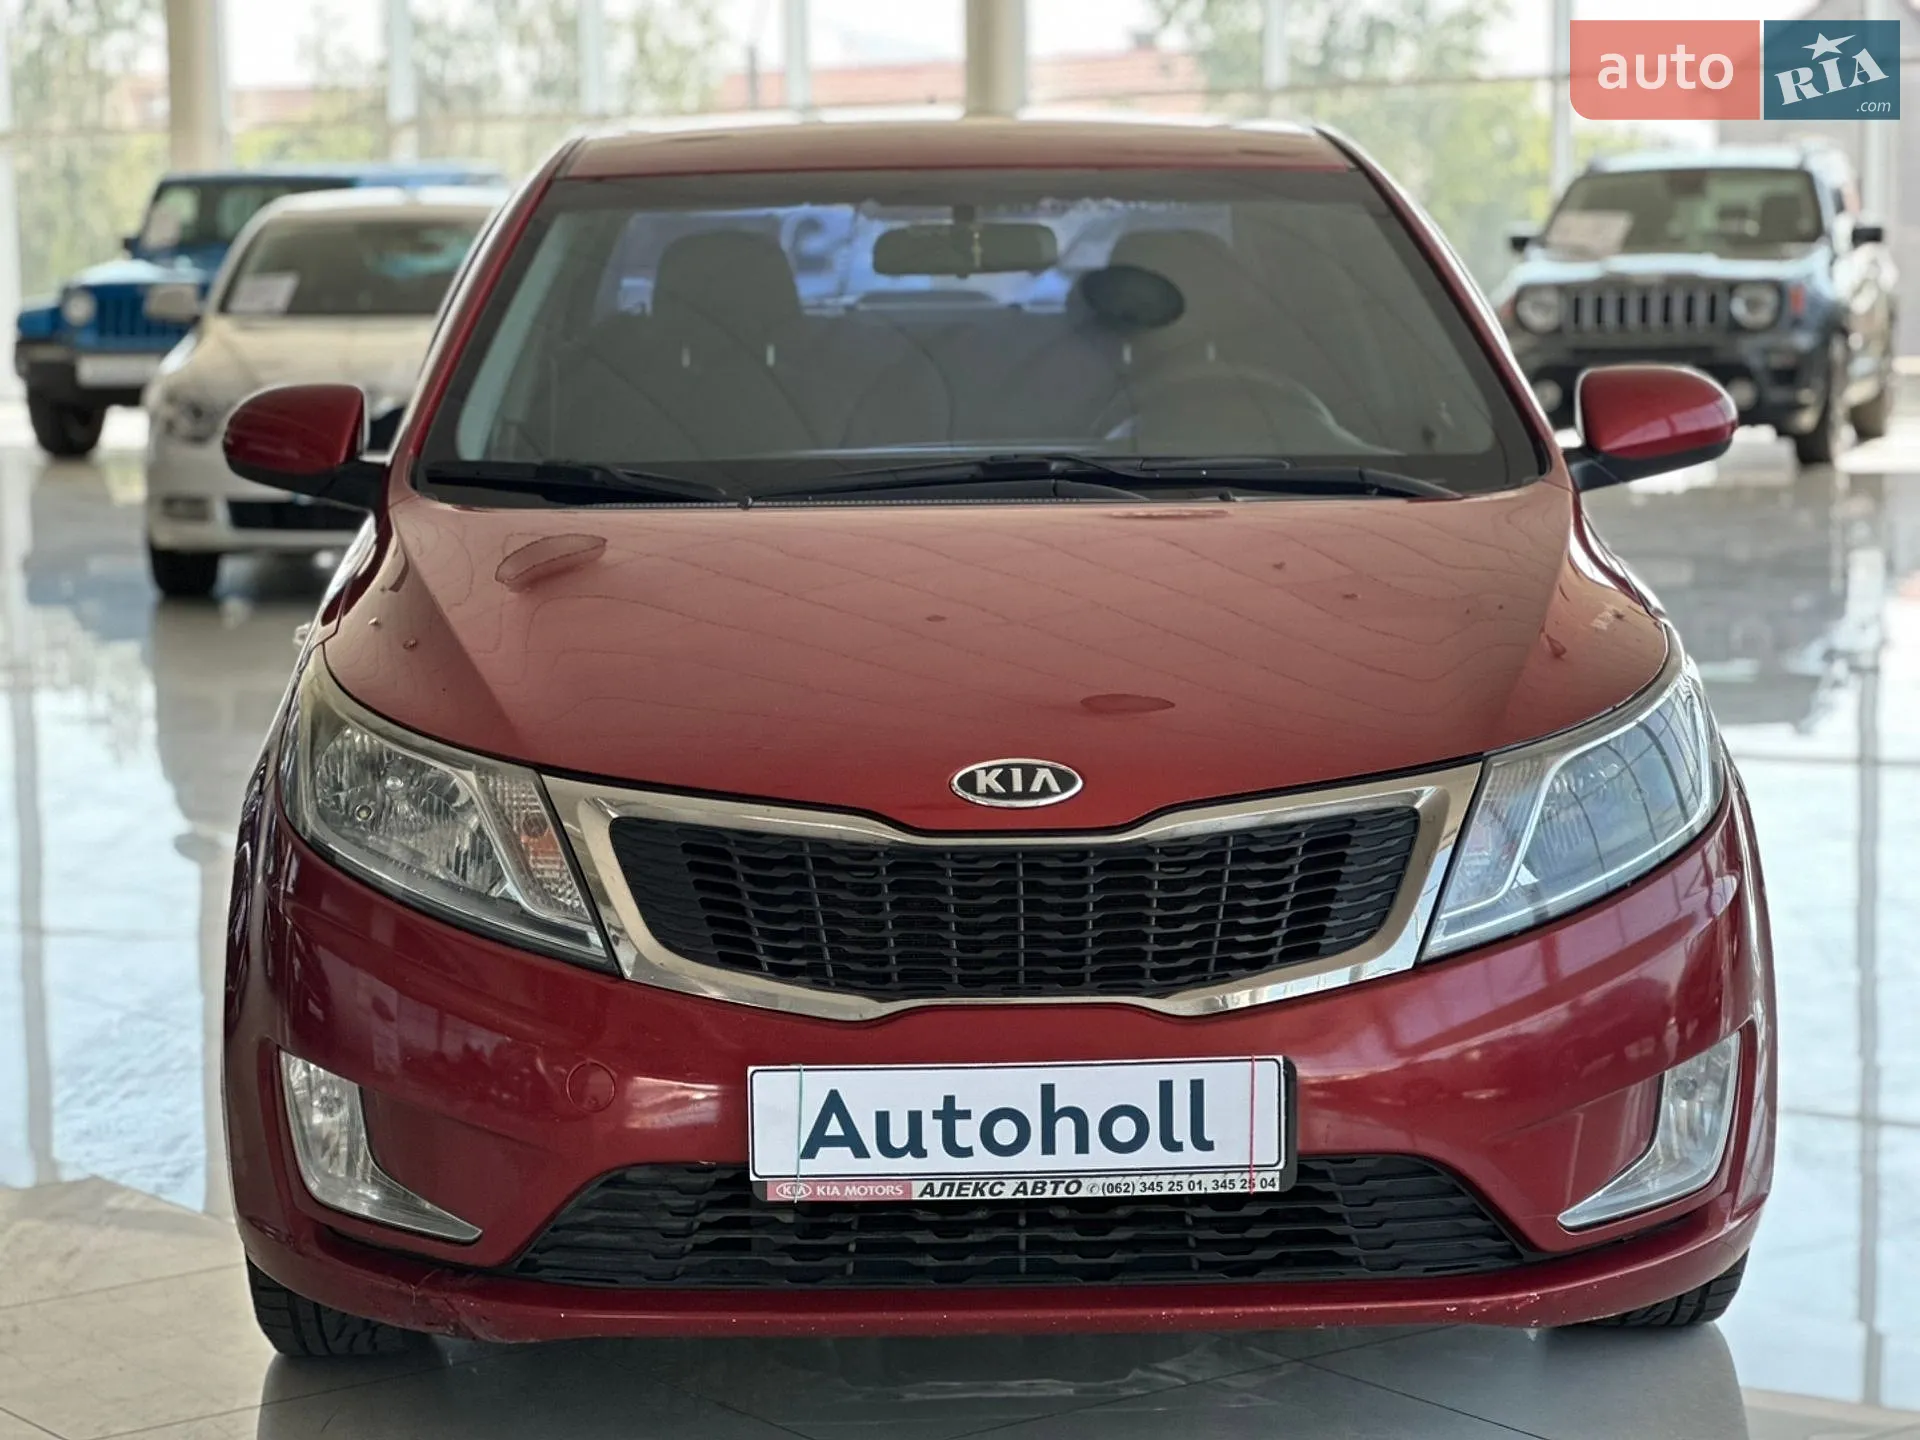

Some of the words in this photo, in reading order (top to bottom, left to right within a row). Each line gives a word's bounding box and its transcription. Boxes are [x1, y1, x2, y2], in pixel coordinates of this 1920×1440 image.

[974, 767, 1062, 795] KIA
[800, 1078, 1215, 1161] Autoholl
[816, 1185, 840, 1196] KIA
[844, 1184, 904, 1197] MOTORS
[918, 1181, 1006, 1198] АЛЕКС
[1011, 1179, 1083, 1197] АВТО
[1101, 1182, 1136, 1196] (062)
[1139, 1181, 1164, 1193] 345
[1167, 1180, 1184, 1193] 25
[1212, 1179, 1236, 1191] 345
[1260, 1177, 1277, 1190] 04
